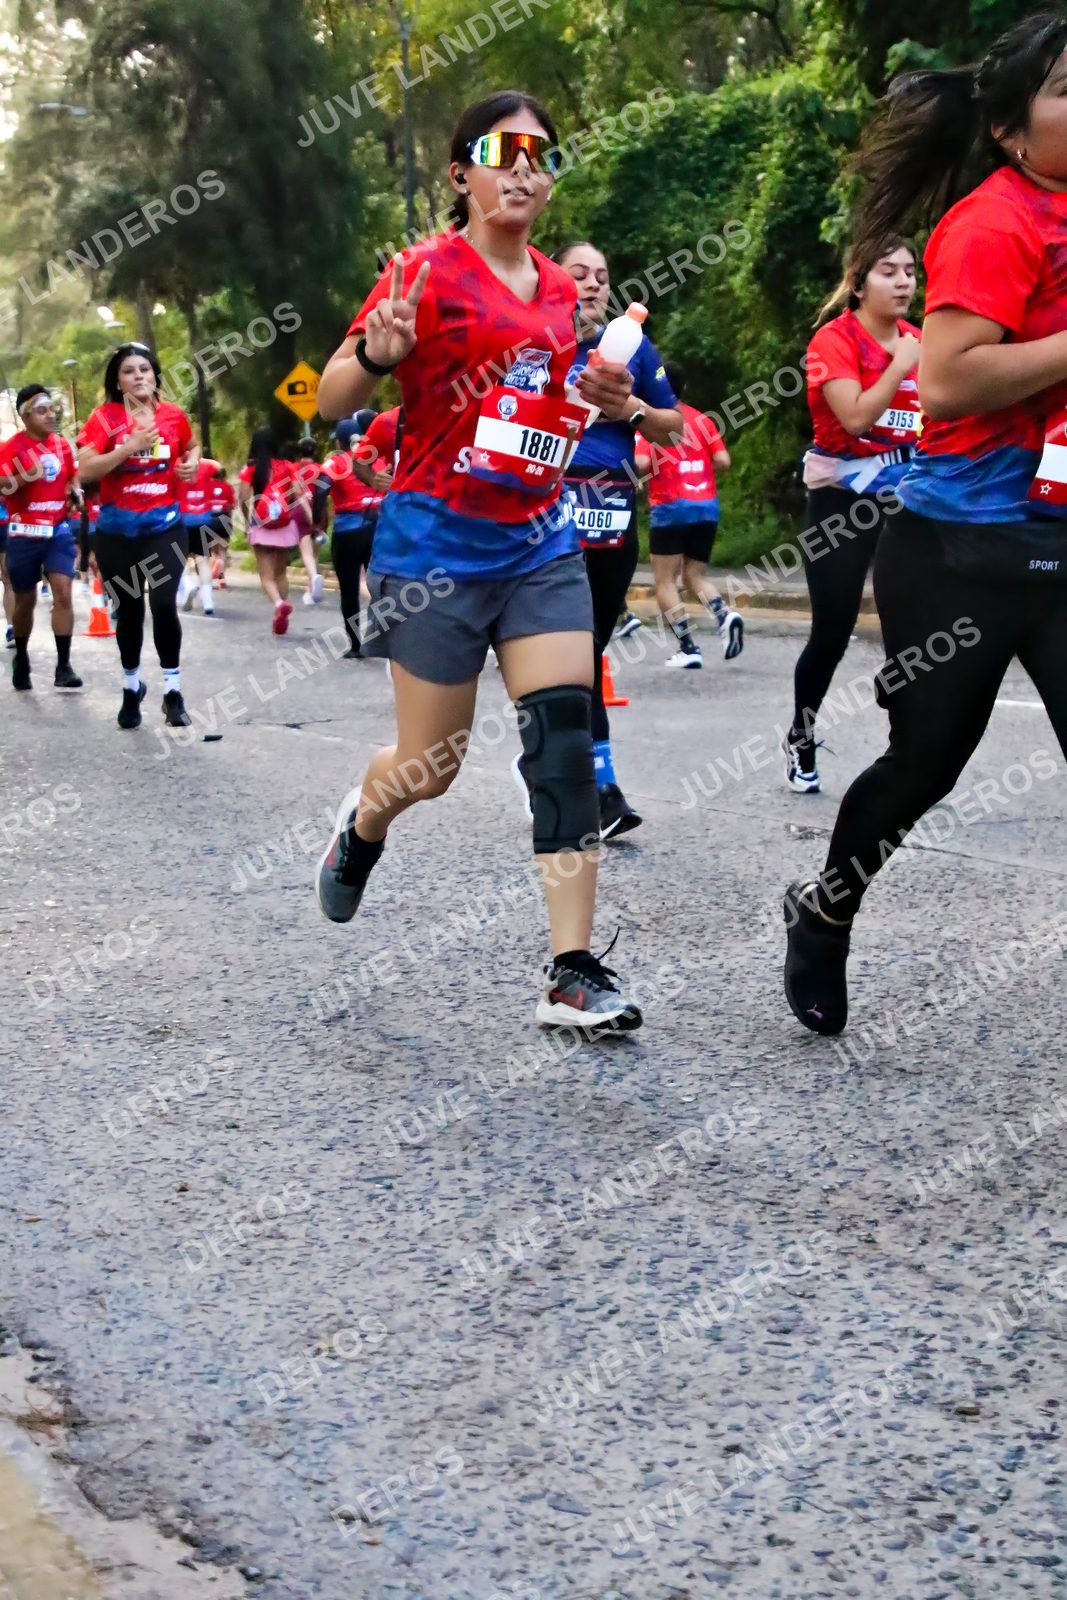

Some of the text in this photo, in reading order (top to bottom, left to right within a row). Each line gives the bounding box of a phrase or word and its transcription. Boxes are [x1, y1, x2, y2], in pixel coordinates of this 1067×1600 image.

[887, 410, 914, 428] 3153
[520, 429, 560, 463] 1881
[578, 511, 612, 528] 4060
[1028, 559, 1060, 571] SPORT
